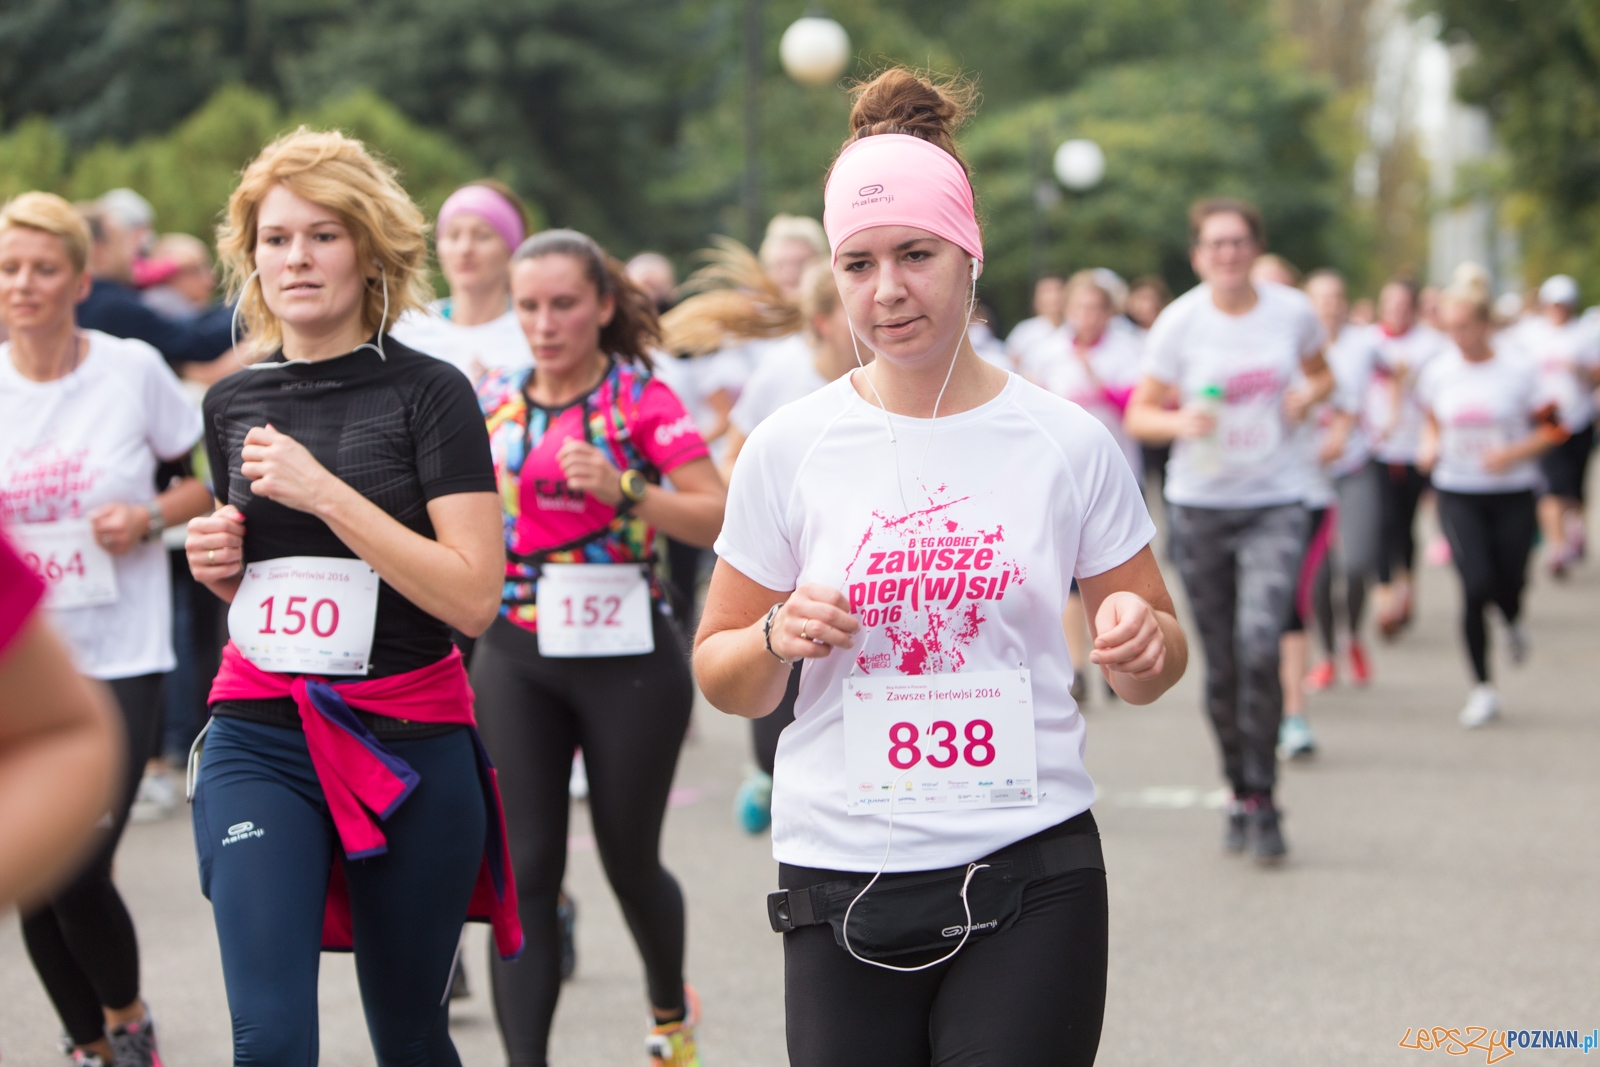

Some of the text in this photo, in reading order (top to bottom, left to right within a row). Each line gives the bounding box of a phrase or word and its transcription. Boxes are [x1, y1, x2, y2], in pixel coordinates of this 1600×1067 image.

[908, 536, 980, 549] BEG KOBIET
[866, 547, 994, 575] zawsze
[849, 570, 1011, 615] pier(w)si!
[258, 596, 340, 638] 150
[561, 595, 623, 627] 152
[861, 605, 902, 628] 2016
[886, 691, 926, 701] Zawsze
[975, 688, 1001, 698] 2016
[887, 719, 996, 770] 838
